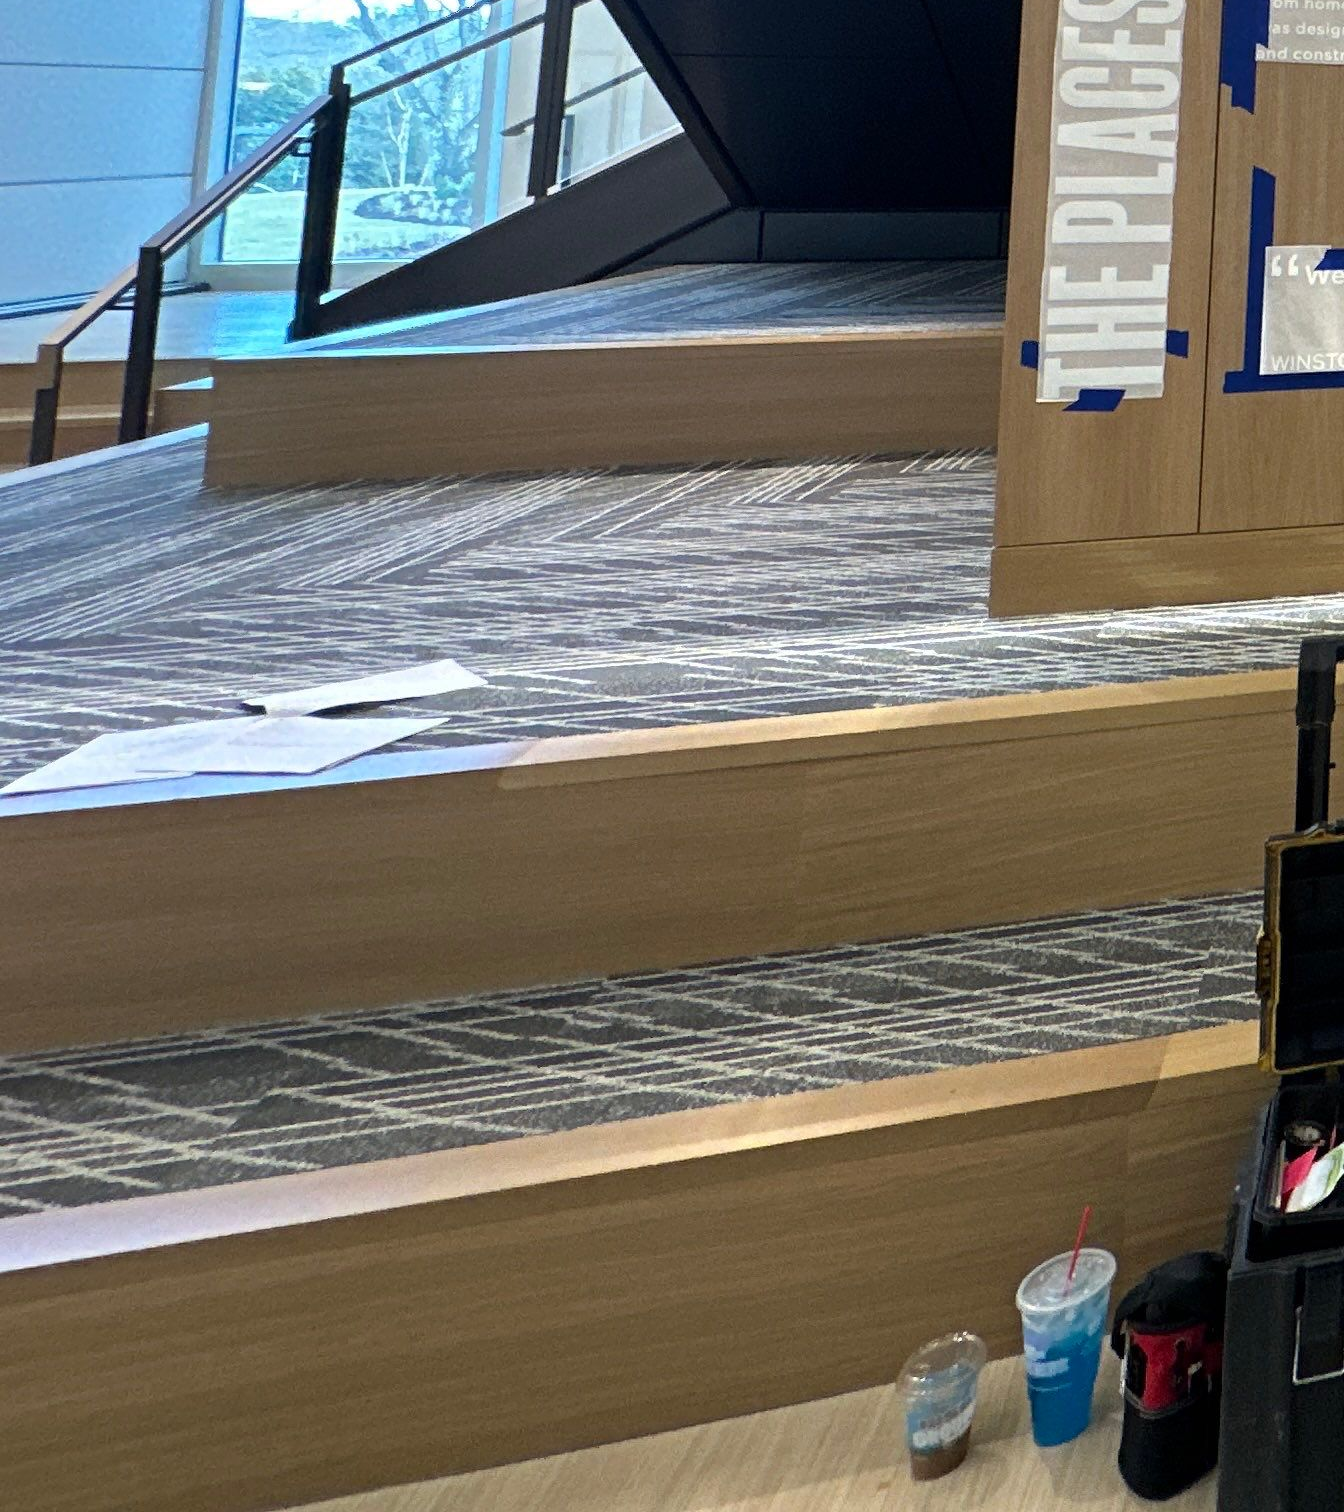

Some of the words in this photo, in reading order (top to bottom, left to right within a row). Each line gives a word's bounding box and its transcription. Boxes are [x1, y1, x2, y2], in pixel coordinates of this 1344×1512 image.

[1270, 25, 1290, 36] as
[1256, 46, 1288, 61] and
[1043, 263, 1169, 399] THE
